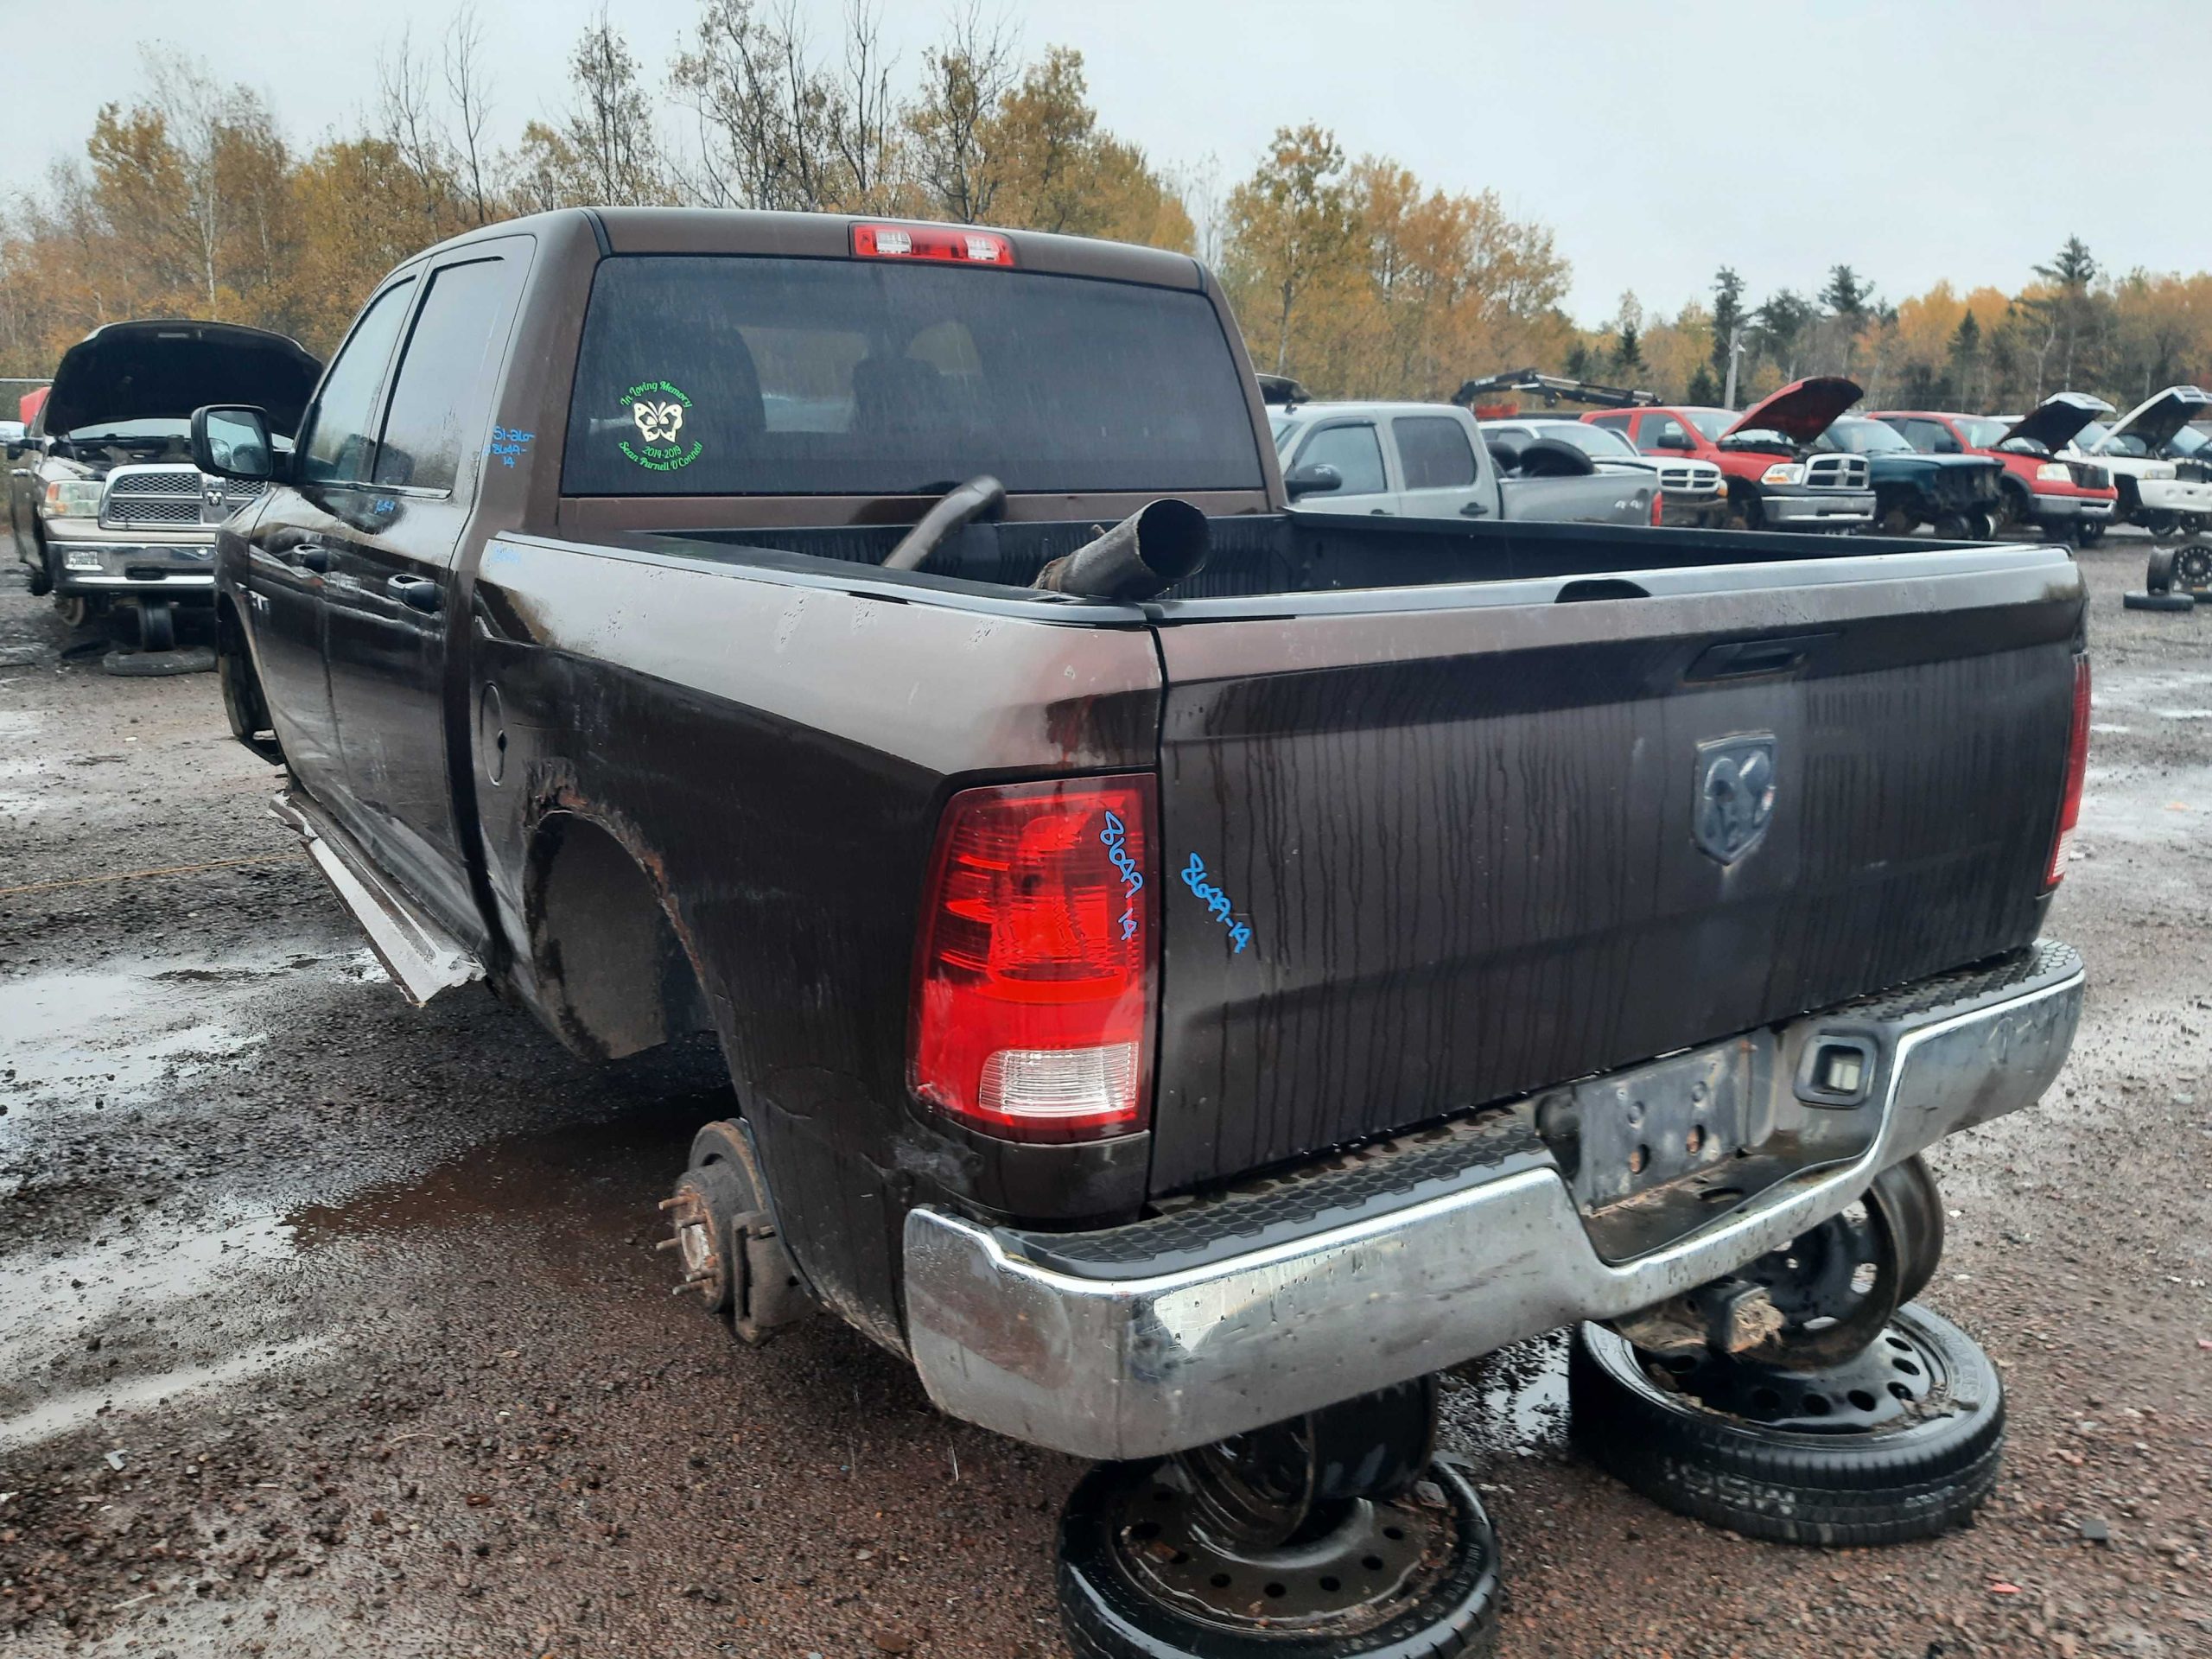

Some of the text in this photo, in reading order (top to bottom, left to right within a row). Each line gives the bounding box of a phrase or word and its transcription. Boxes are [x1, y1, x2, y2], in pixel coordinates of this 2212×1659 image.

[620, 380, 693, 408] In Loving Memory
[619, 441, 639, 462] Sean
[671, 441, 703, 470] O'Connell
